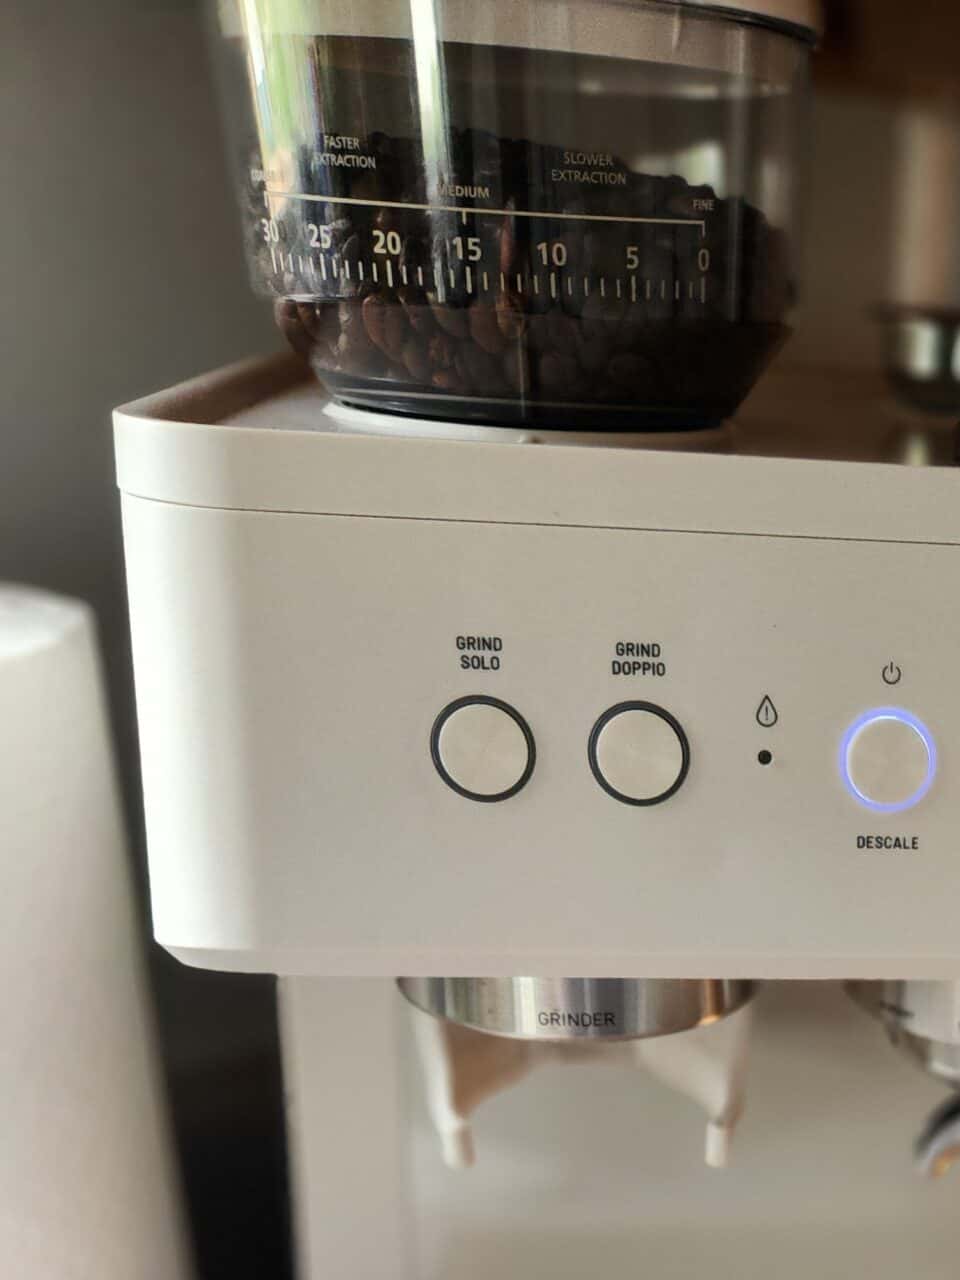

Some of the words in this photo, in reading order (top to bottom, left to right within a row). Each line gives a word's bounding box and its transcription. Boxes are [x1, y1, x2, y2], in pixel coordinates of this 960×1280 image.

[323, 135, 360, 150] FASTER
[563, 151, 614, 167] SLOWER
[551, 169, 627, 185] EXTRACTION
[437, 184, 490, 199] MEDIUM
[692, 199, 715, 211] FINE
[261, 218, 279, 242] 30
[307, 223, 332, 249] 25
[372, 230, 401, 255] 20
[452, 237, 482, 262] 15
[536, 242, 567, 267] 10
[626, 246, 639, 270] 5
[698, 249, 710, 271] 0
[455, 636, 503, 652] GRIND
[615, 642, 661, 658] GRIND
[460, 655, 500, 671] SOLO
[611, 660, 666, 677] DOPPIO
[856, 835, 918, 850] DESCALE
[538, 1012, 616, 1027] GRINDER
